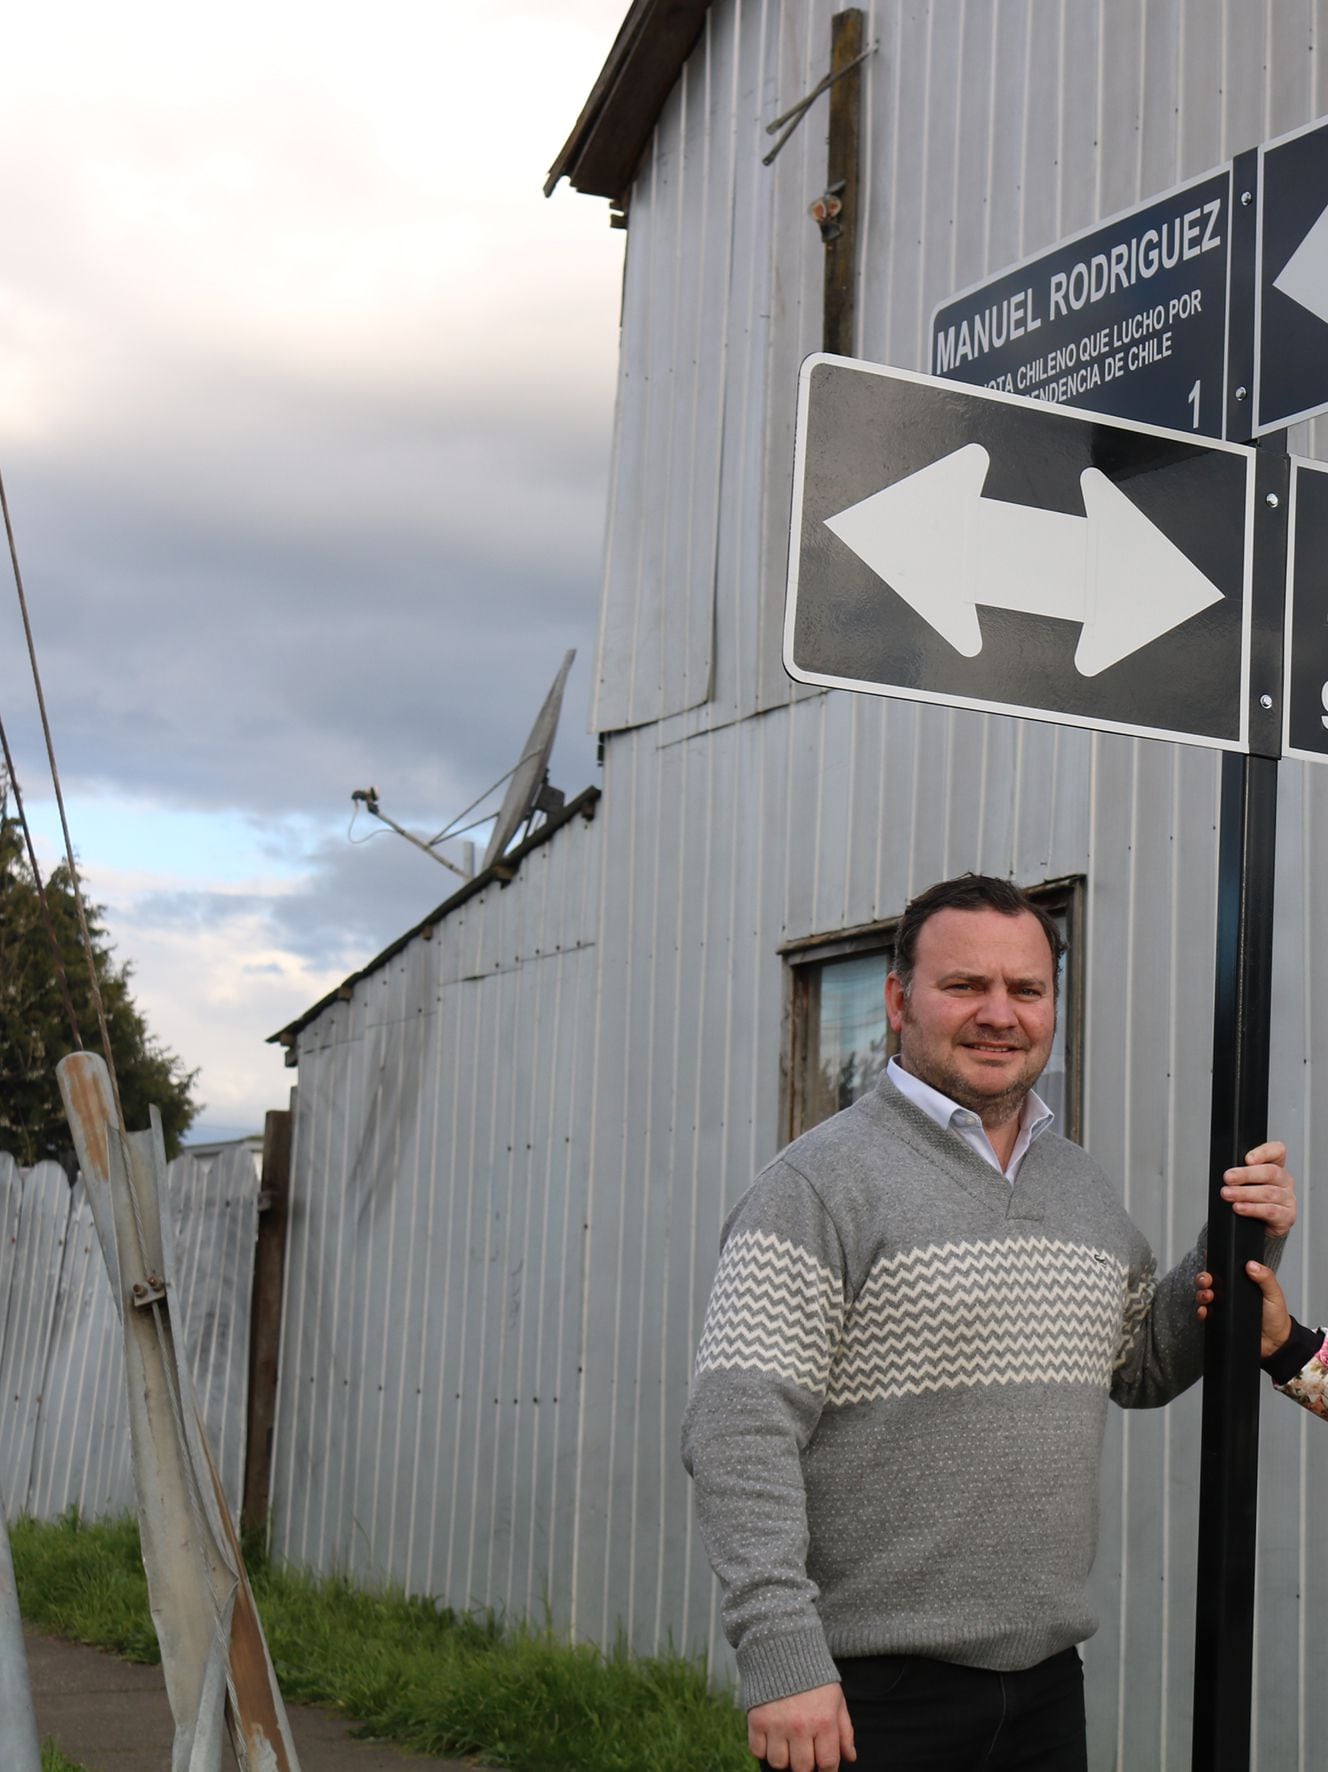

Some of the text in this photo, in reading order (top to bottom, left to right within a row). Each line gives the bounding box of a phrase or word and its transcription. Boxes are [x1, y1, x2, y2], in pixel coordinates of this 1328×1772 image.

[936, 198, 1221, 376] MANUEL RODRIGUEZ
[1016, 342, 1077, 391] CHILENO
[1079, 327, 1110, 362] QUE
[1113, 304, 1165, 348] LUCHO
[1168, 288, 1202, 324] POR
[1104, 352, 1125, 382] DE
[1128, 331, 1173, 371] CHILE
[1188, 379, 1201, 429] 1
